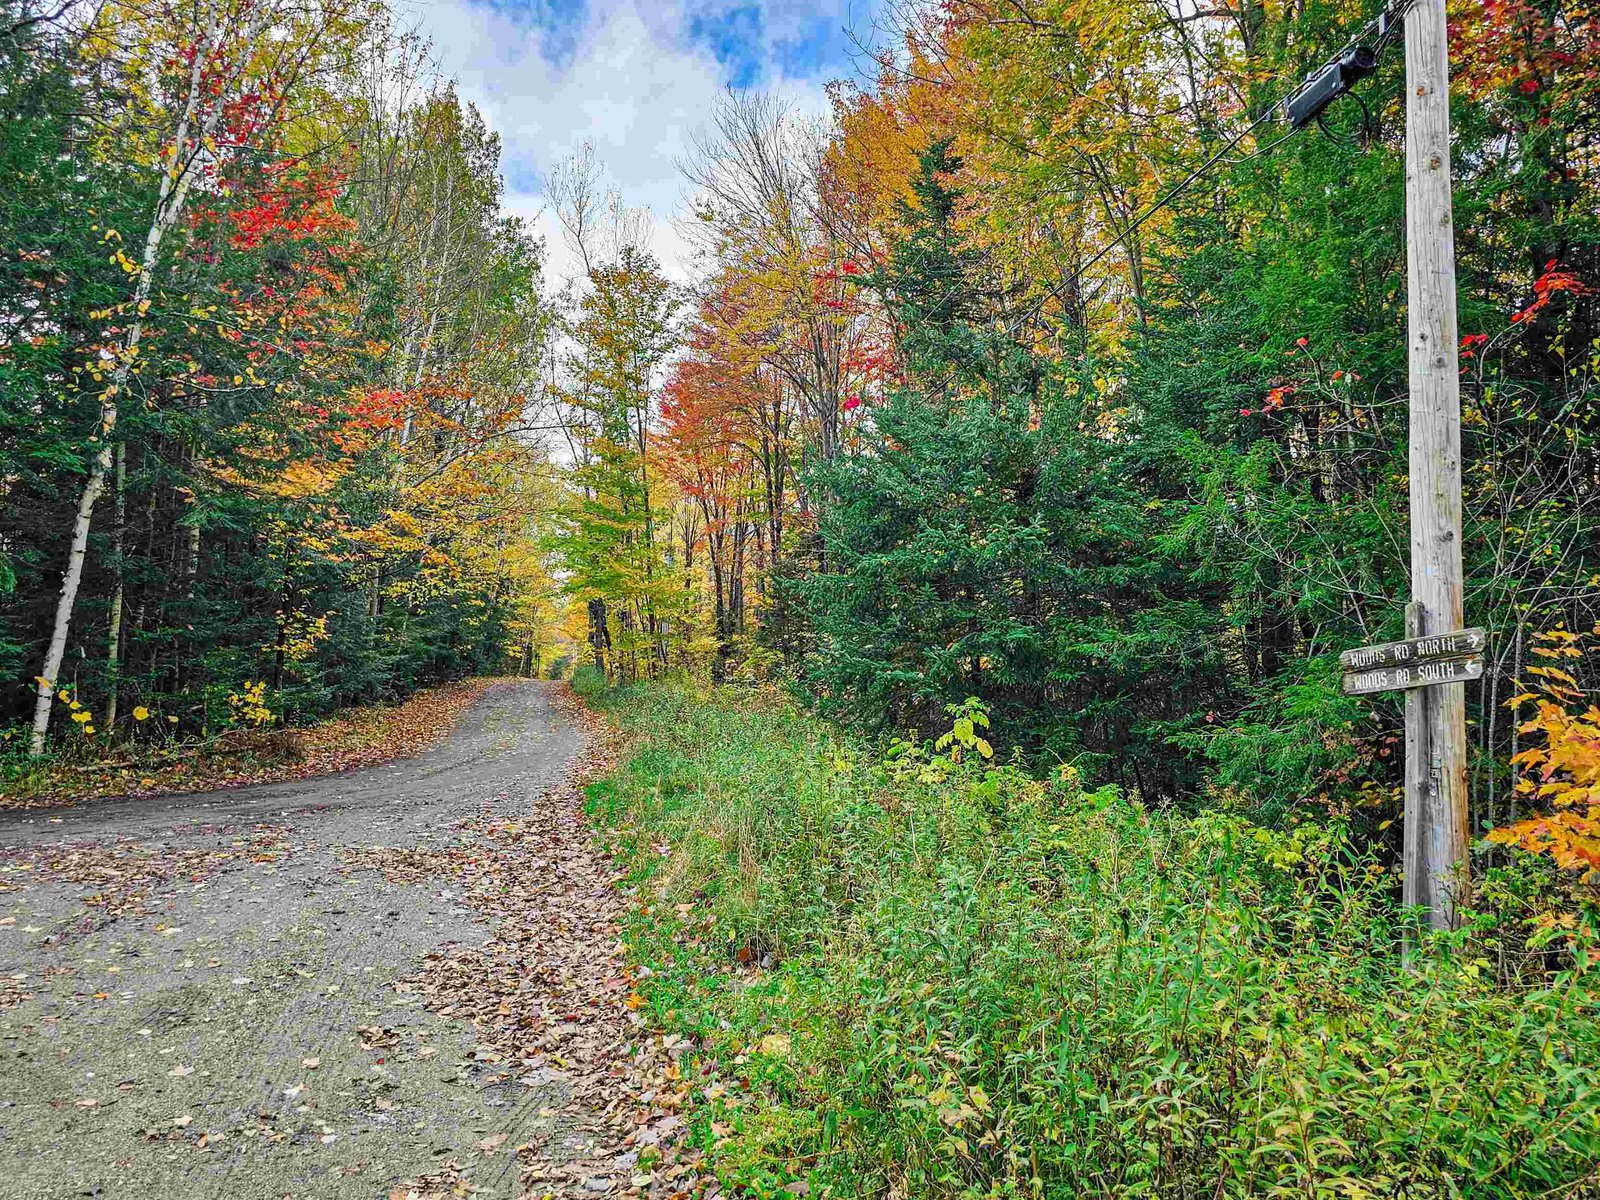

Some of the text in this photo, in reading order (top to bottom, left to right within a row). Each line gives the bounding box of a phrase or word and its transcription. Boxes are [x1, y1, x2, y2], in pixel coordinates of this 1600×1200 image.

[1394, 645, 1409, 660] RD
[1417, 638, 1456, 656] NORTH
[1354, 662, 1455, 690] WOODS RD SOUTH
